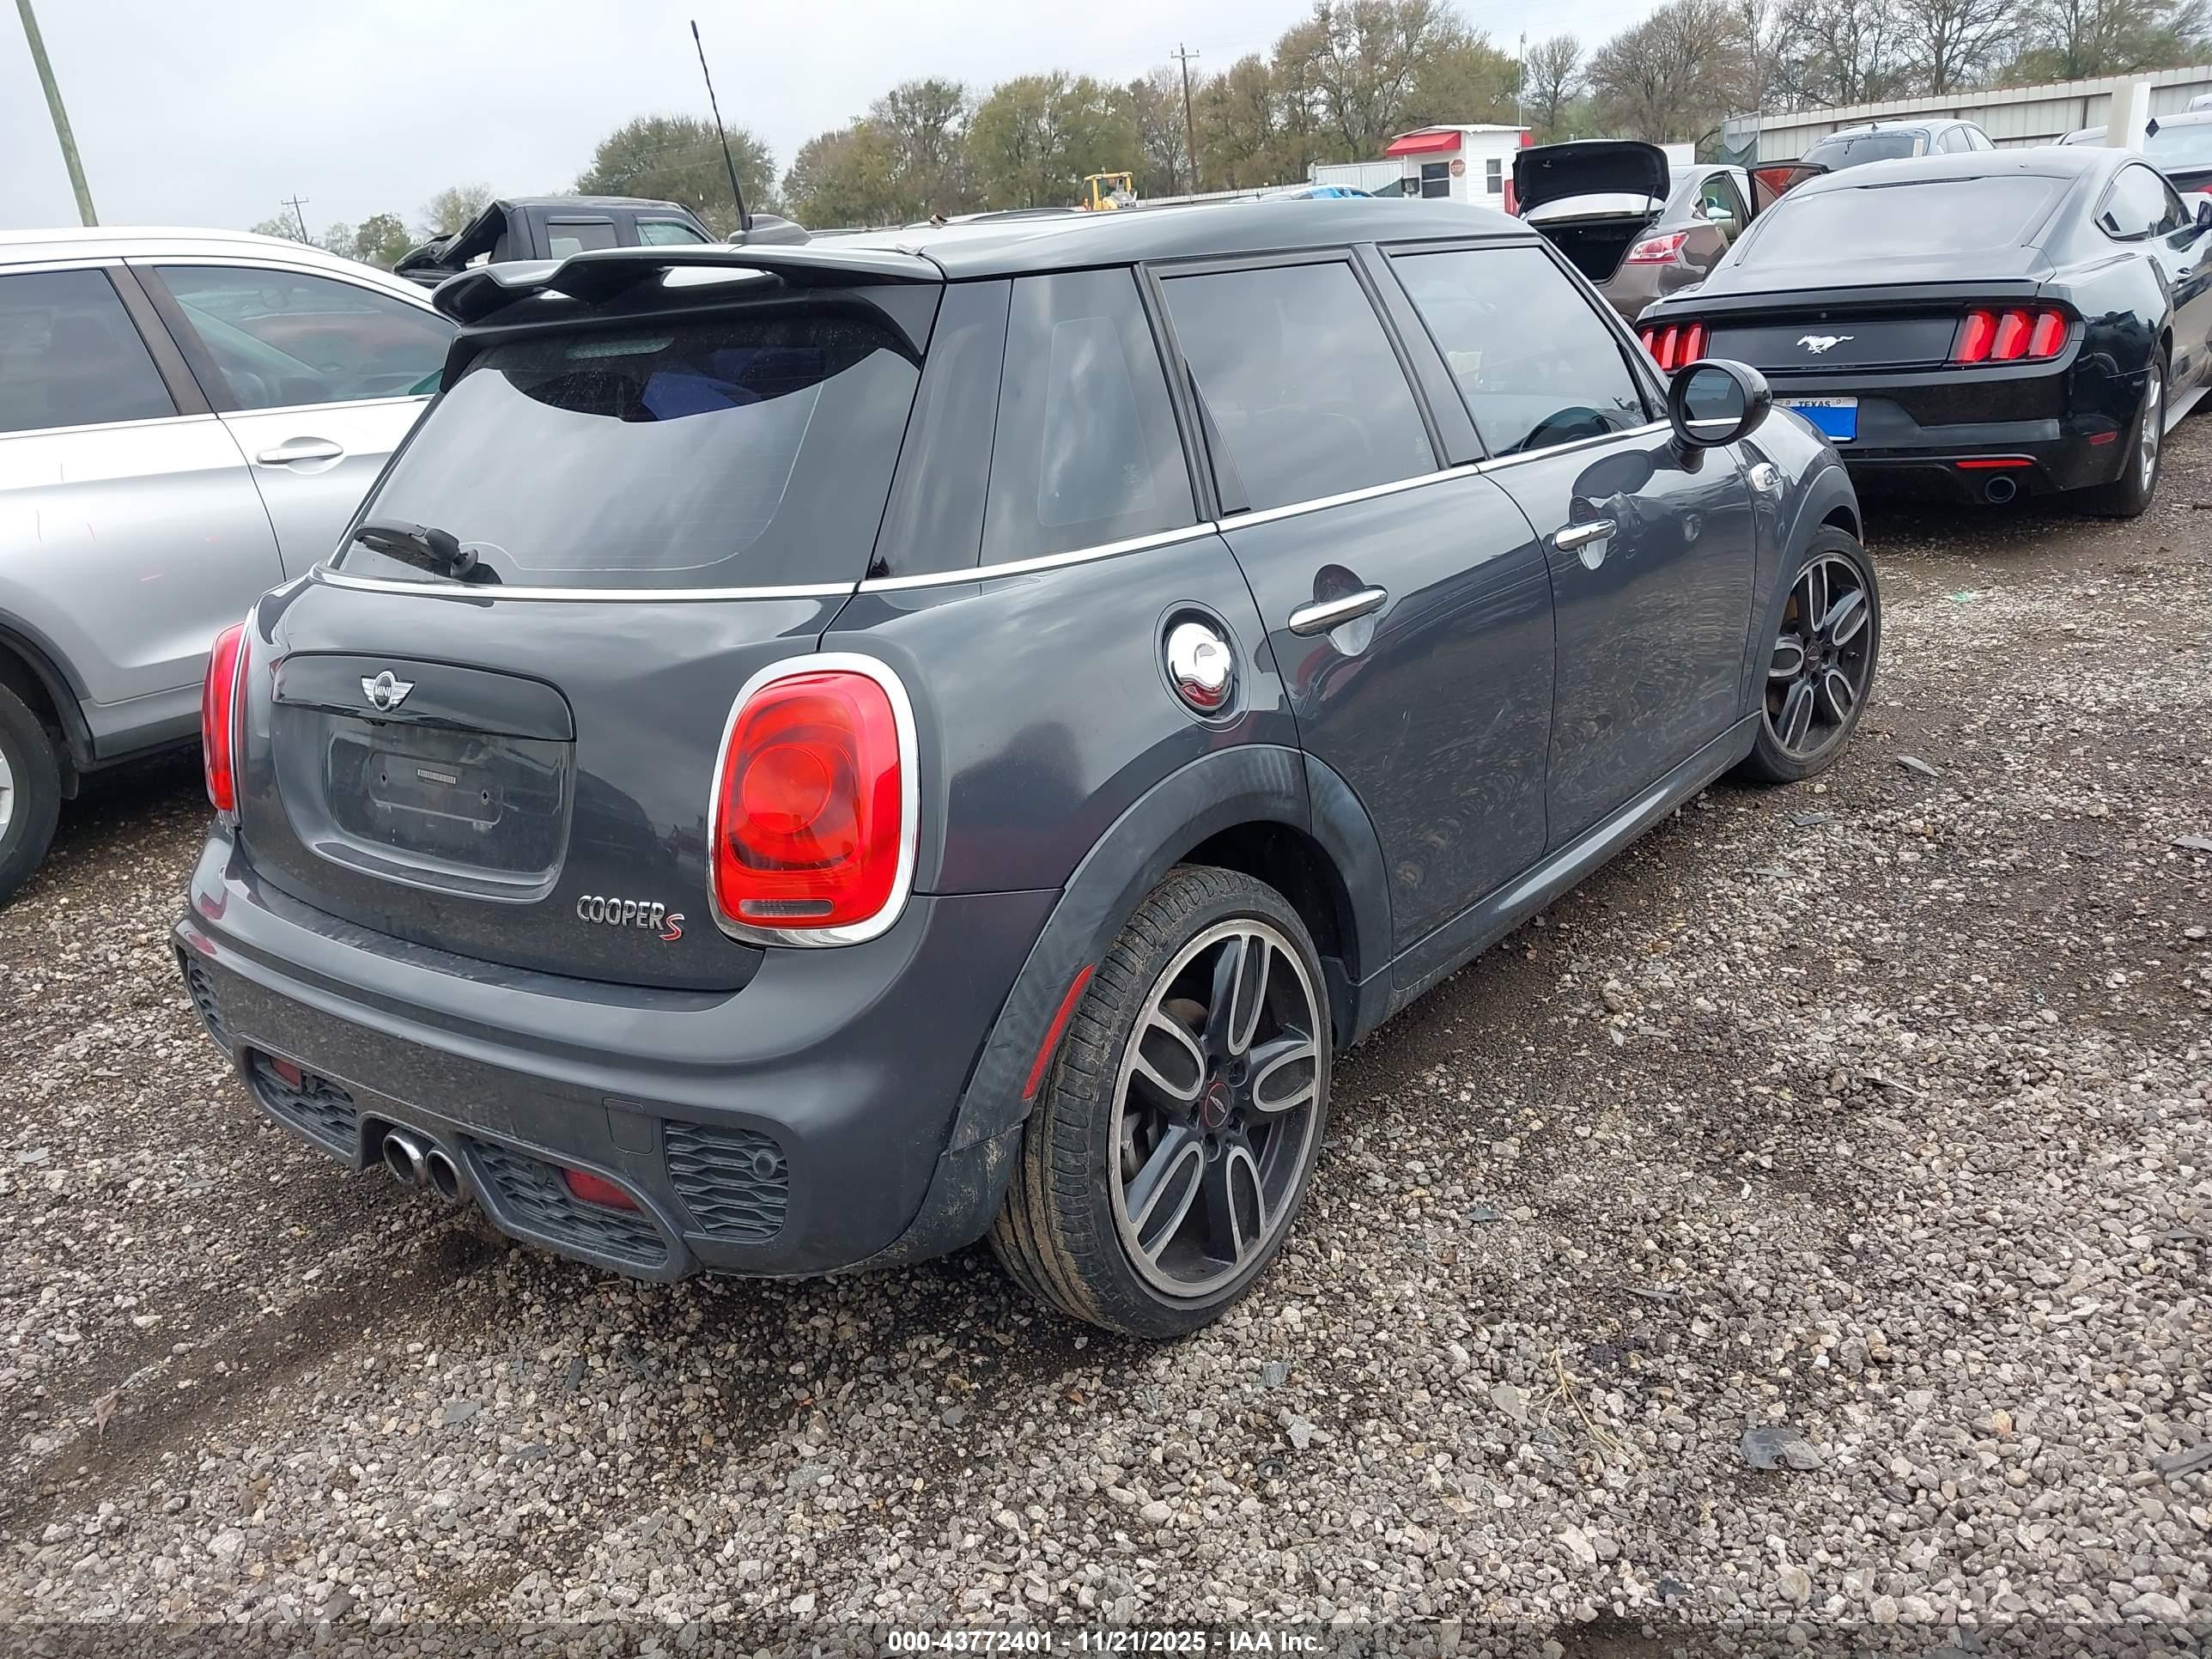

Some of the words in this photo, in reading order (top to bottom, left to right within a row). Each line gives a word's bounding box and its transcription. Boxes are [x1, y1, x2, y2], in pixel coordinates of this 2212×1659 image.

[1451, 164, 1465, 173] STOP
[1798, 400, 1832, 409] TEXAS
[374, 685, 392, 697] MINI
[576, 895, 665, 931] COOPER
